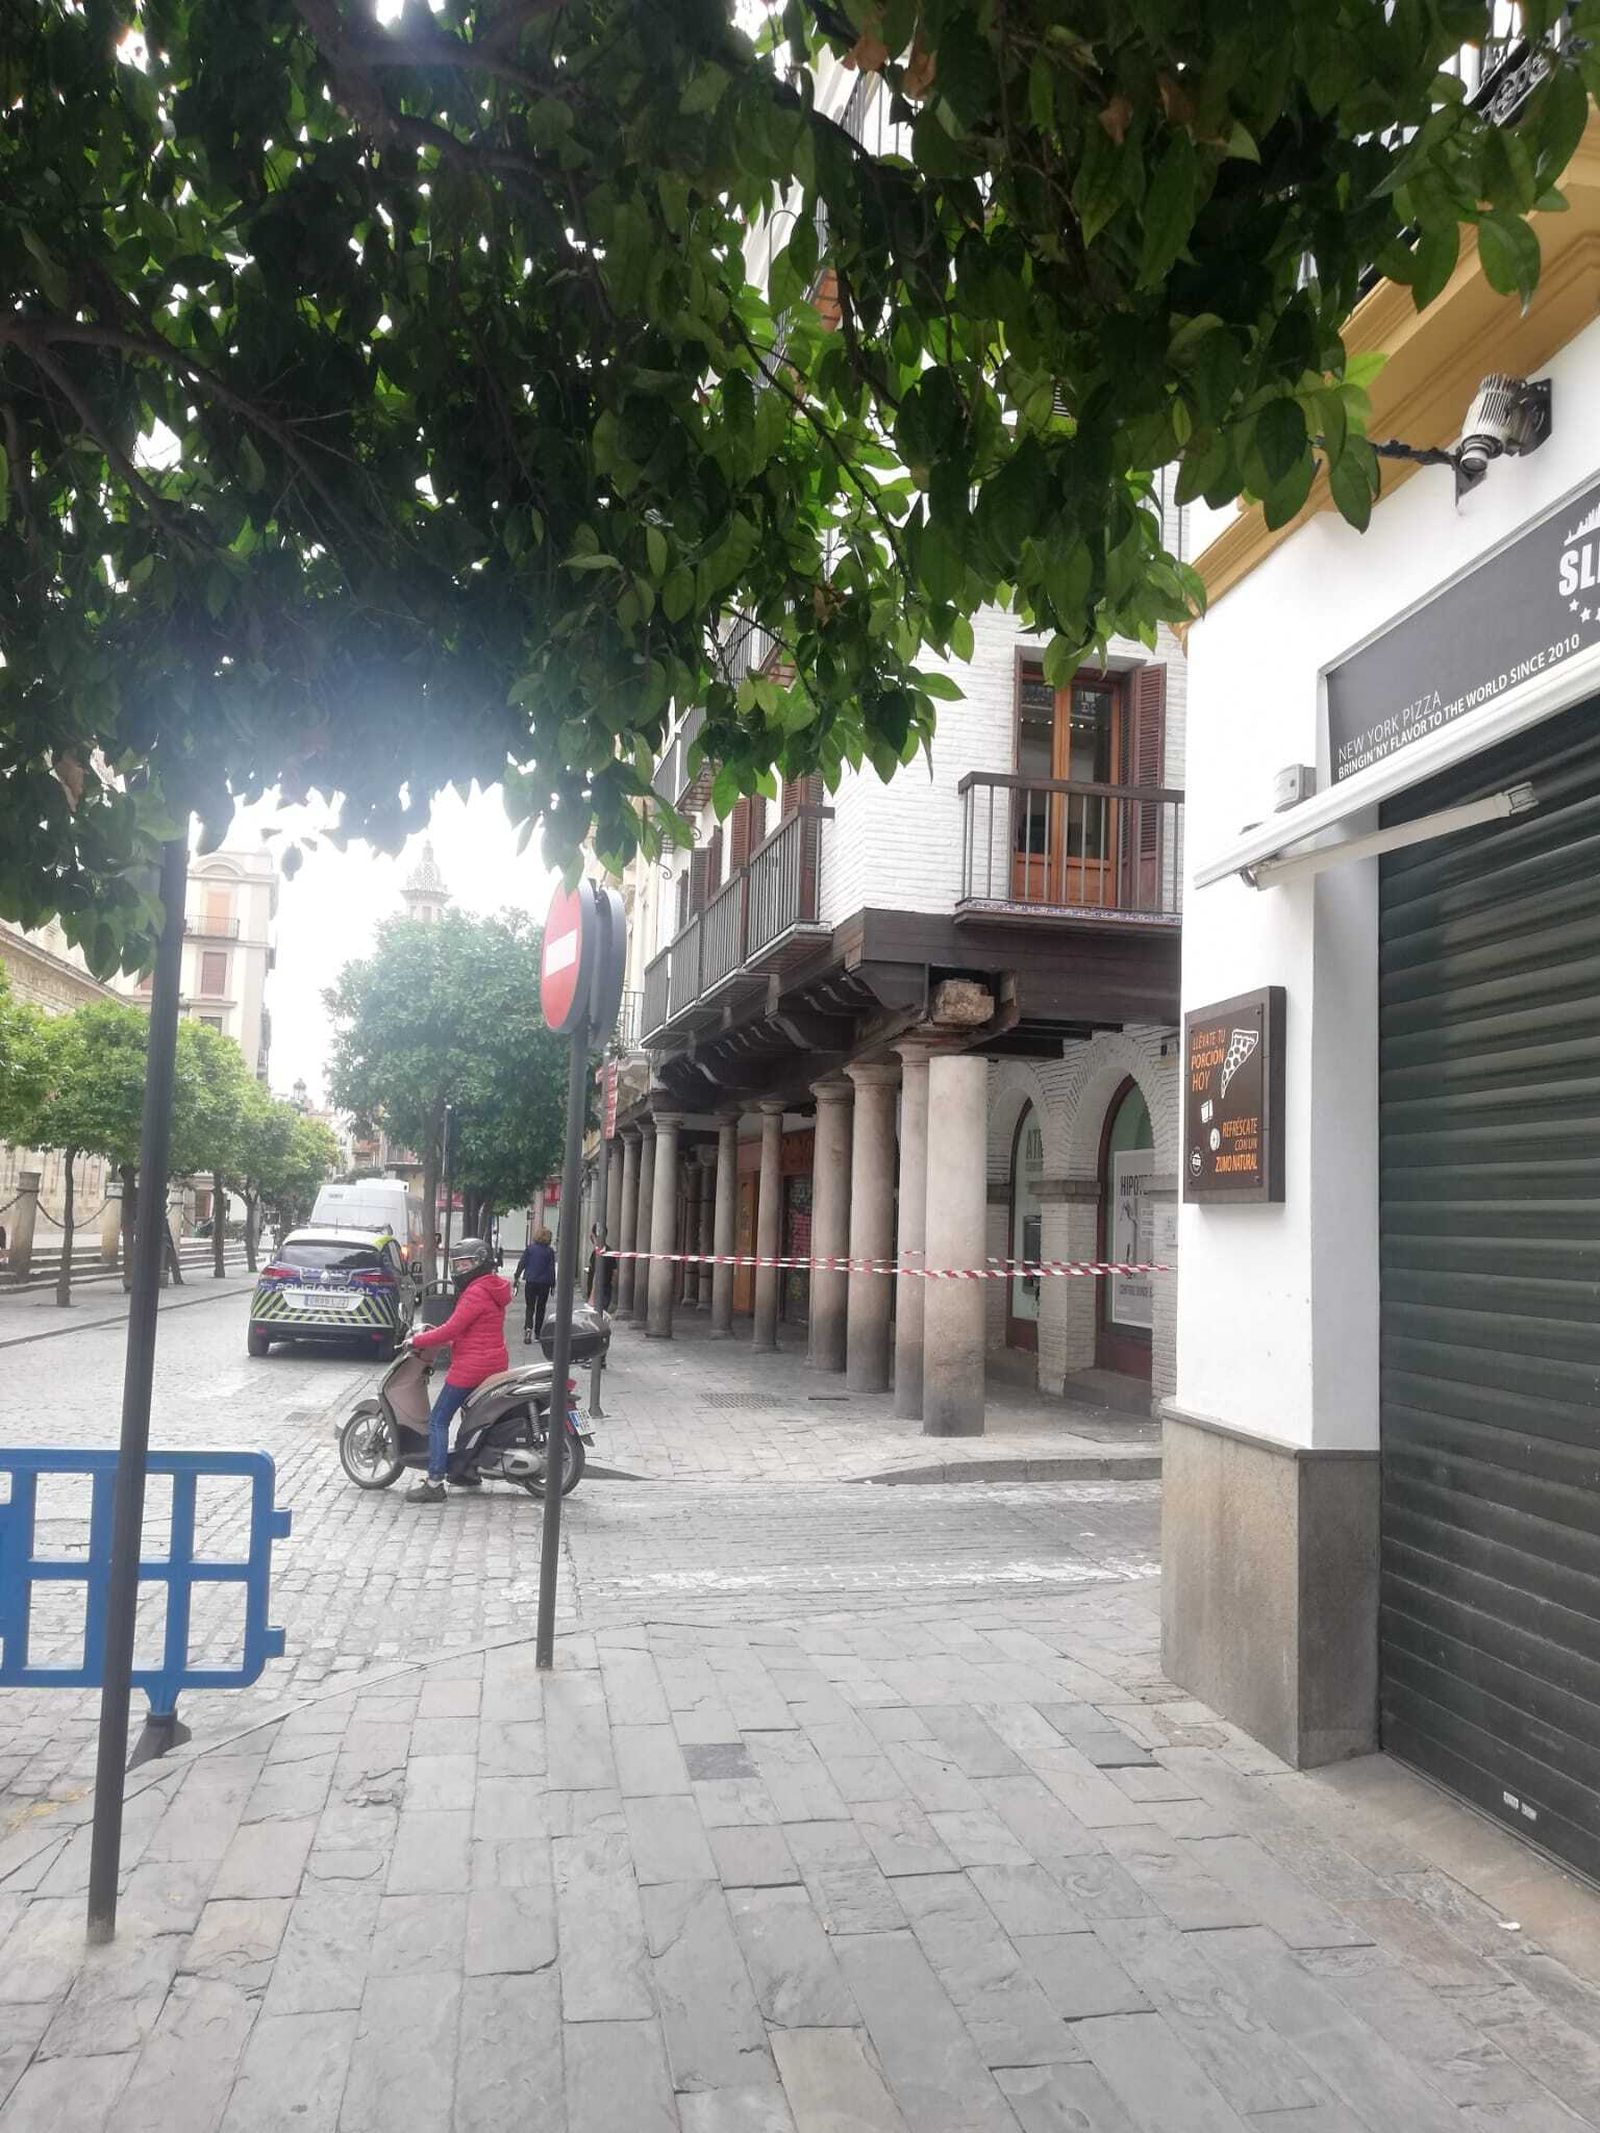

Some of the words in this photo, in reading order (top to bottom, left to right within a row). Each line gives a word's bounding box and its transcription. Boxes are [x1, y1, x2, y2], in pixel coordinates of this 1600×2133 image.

[1390, 719, 1427, 751] FLAVOR
[1428, 711, 1442, 730] TO
[1443, 698, 1465, 720] THE
[1466, 674, 1507, 708] WORLD
[1510, 651, 1545, 684] SINCE
[1548, 633, 1580, 663] 2010
[1338, 733, 1364, 763] NEW
[1367, 713, 1399, 746] YORK
[1402, 690, 1442, 727] PIZZA
[1192, 1070, 1211, 1093] HOY
[329, 1285, 374, 1296] LOCAL
